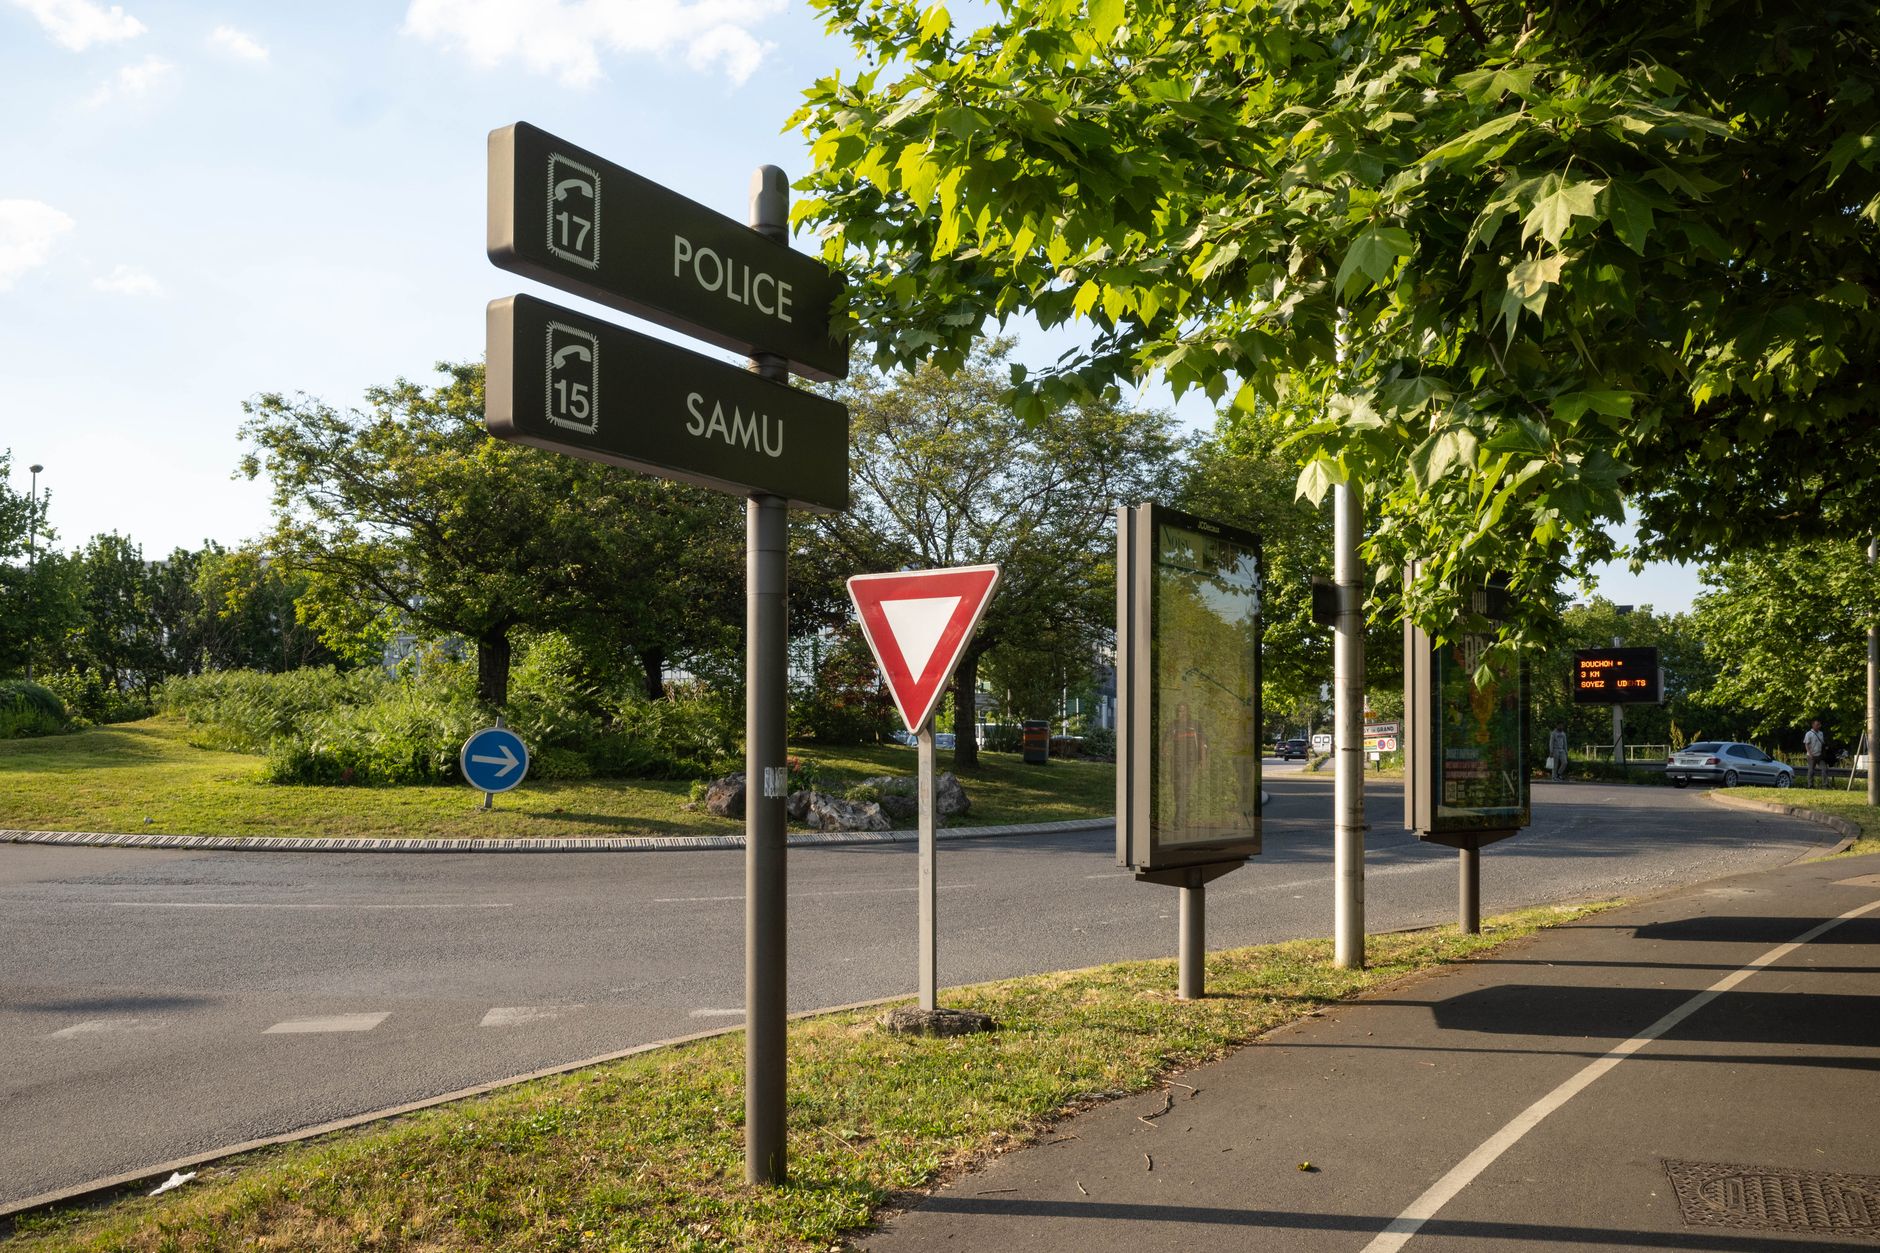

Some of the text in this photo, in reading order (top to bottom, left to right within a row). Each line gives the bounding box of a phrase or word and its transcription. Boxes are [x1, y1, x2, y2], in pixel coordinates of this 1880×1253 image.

[554, 211, 591, 252] 17
[673, 233, 793, 324] POLICE
[554, 378, 590, 419] 15
[685, 391, 784, 459] SAMU
[1581, 660, 1614, 668] BOUCHON
[1581, 680, 1605, 688] SOYEZ
[1590, 670, 1600, 678] KM
